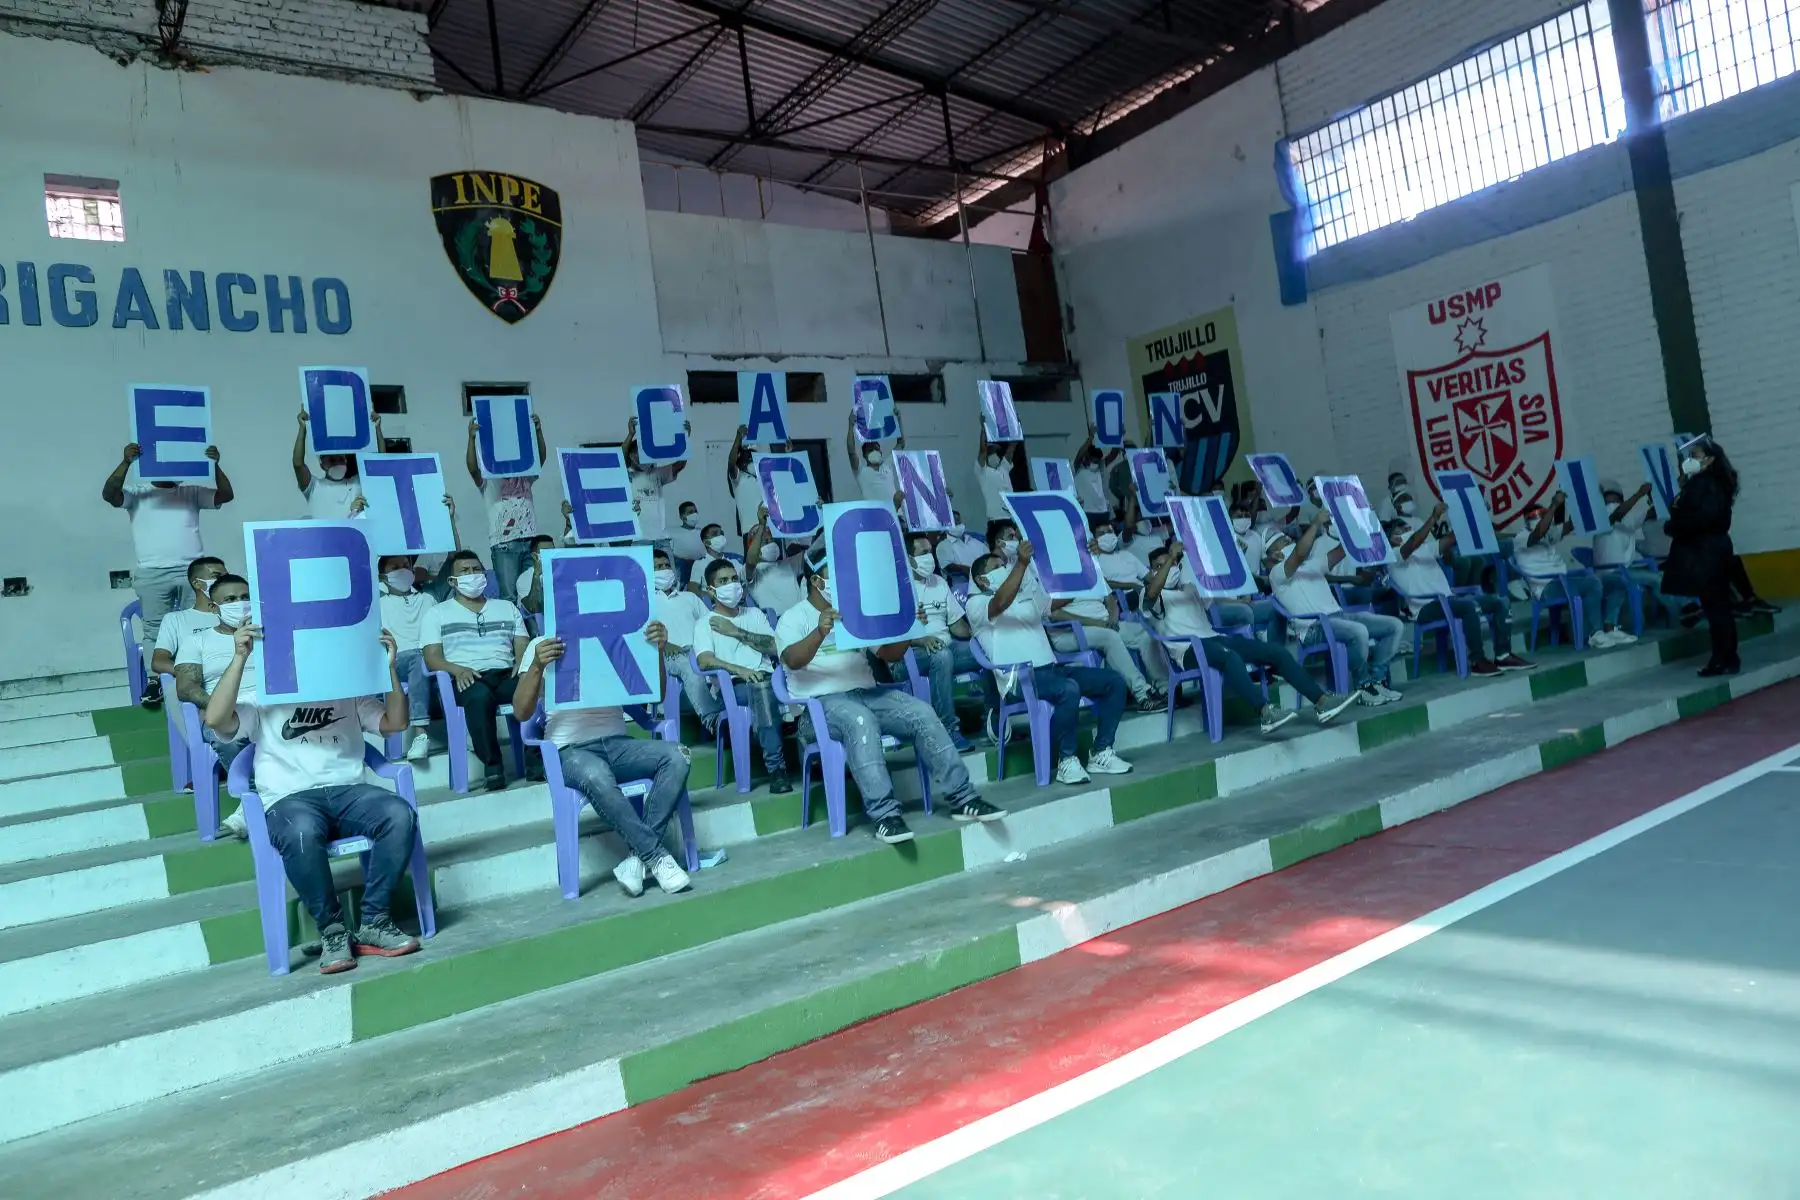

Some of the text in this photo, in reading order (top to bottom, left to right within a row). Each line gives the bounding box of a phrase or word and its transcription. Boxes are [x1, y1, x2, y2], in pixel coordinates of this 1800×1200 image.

[452, 173, 542, 214] INPE
[0, 261, 352, 335] IGANCHO
[1427, 282, 1502, 325] USMP
[1145, 322, 1216, 363] TRUJILLO
[1168, 372, 1207, 393] TRUJILLO
[1427, 358, 1526, 402] VERITAS
[134, 388, 210, 478] E
[304, 370, 371, 452] D
[478, 399, 535, 474] U
[637, 388, 687, 459] C
[747, 373, 787, 441] A
[855, 380, 897, 439] C
[1095, 392, 1123, 445] O
[1151, 394, 1184, 446] N
[1180, 384, 1224, 429] CV
[1519, 393, 1550, 445] VOS
[364, 457, 438, 550] T
[562, 452, 636, 539] E
[759, 457, 820, 534] C
[902, 450, 953, 529] N
[1133, 451, 1170, 513] C
[253, 526, 373, 695] P
[551, 555, 652, 703] R
[831, 508, 917, 640] O
[1008, 495, 1098, 592] D
[1167, 499, 1247, 591] U
[1322, 480, 1387, 563] C
[1438, 473, 1485, 549] T
[1567, 461, 1597, 532] I
[291, 707, 334, 724] NIKE
[301, 736, 338, 744] AIR
